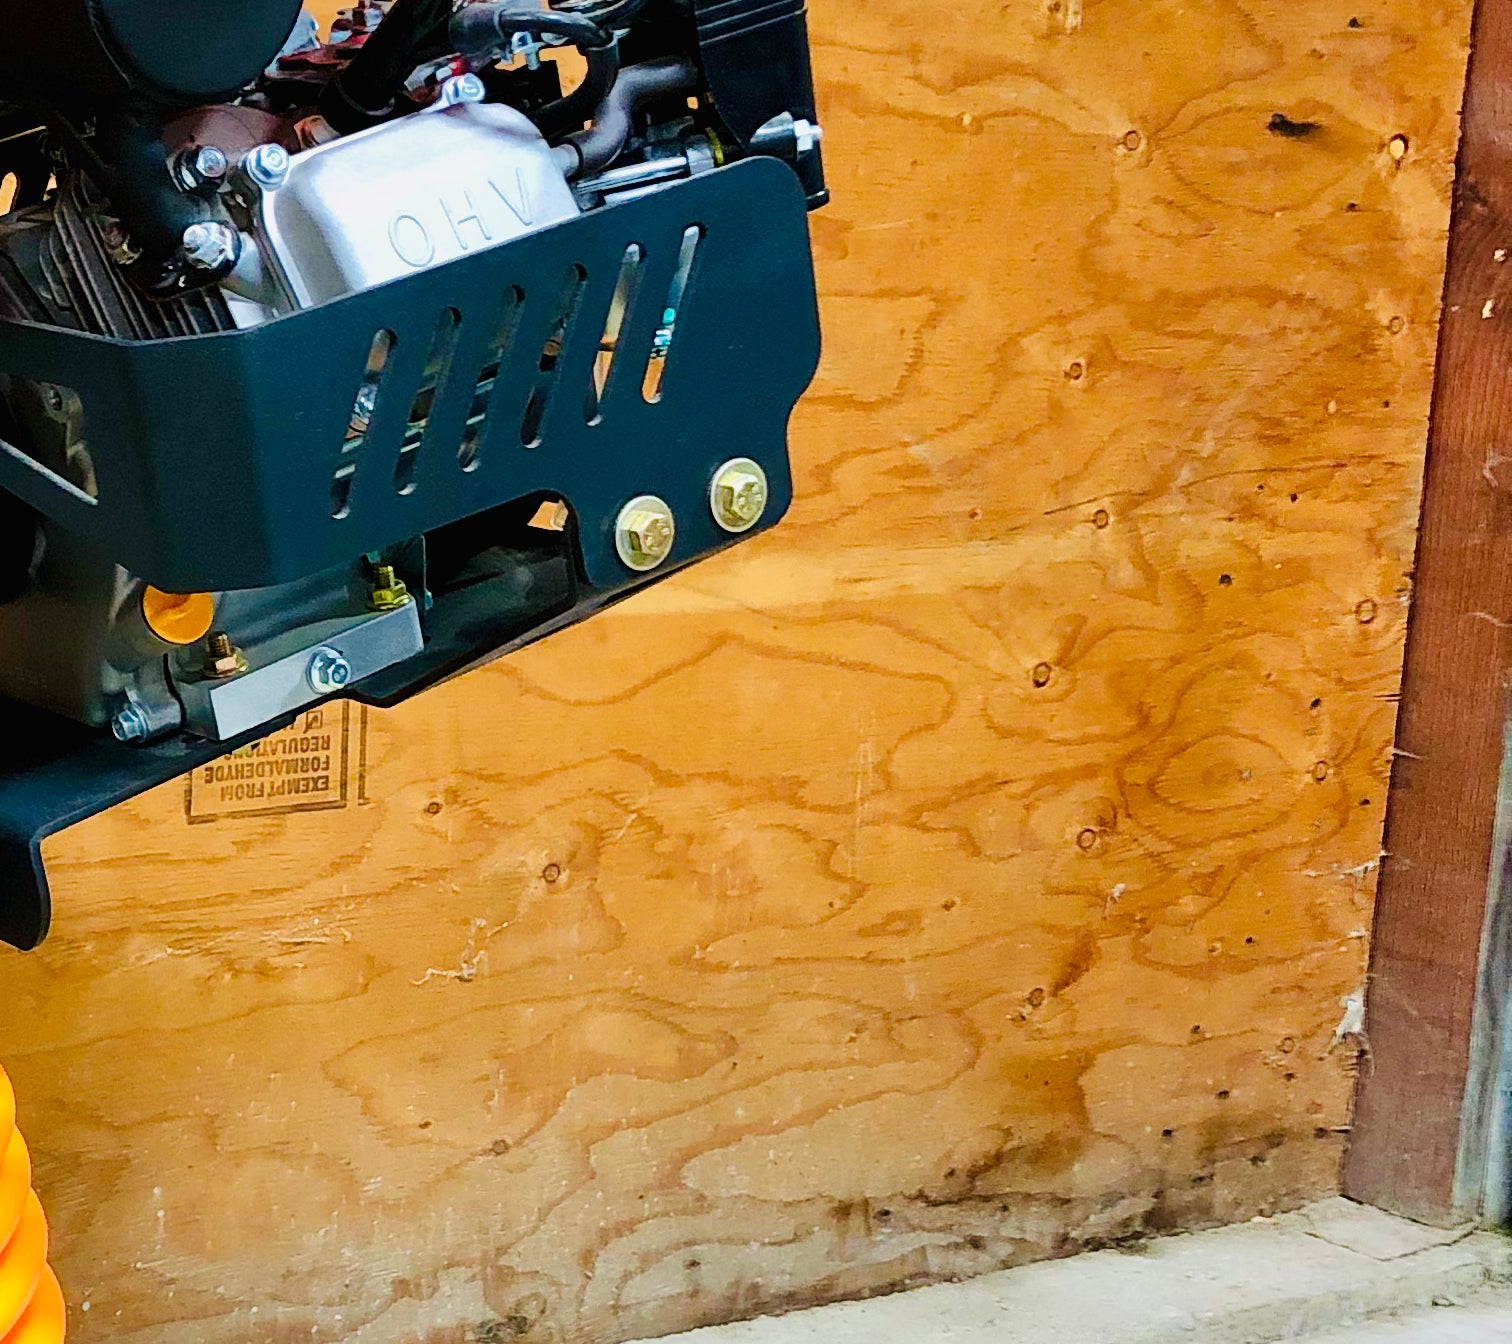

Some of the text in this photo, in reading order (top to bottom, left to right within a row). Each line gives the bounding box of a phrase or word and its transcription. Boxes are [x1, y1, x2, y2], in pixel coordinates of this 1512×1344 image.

[388, 167, 534, 267] OHV
[204, 755, 330, 784] FORMALDEHYDE
[220, 775, 329, 802] EXEMPT FROM
